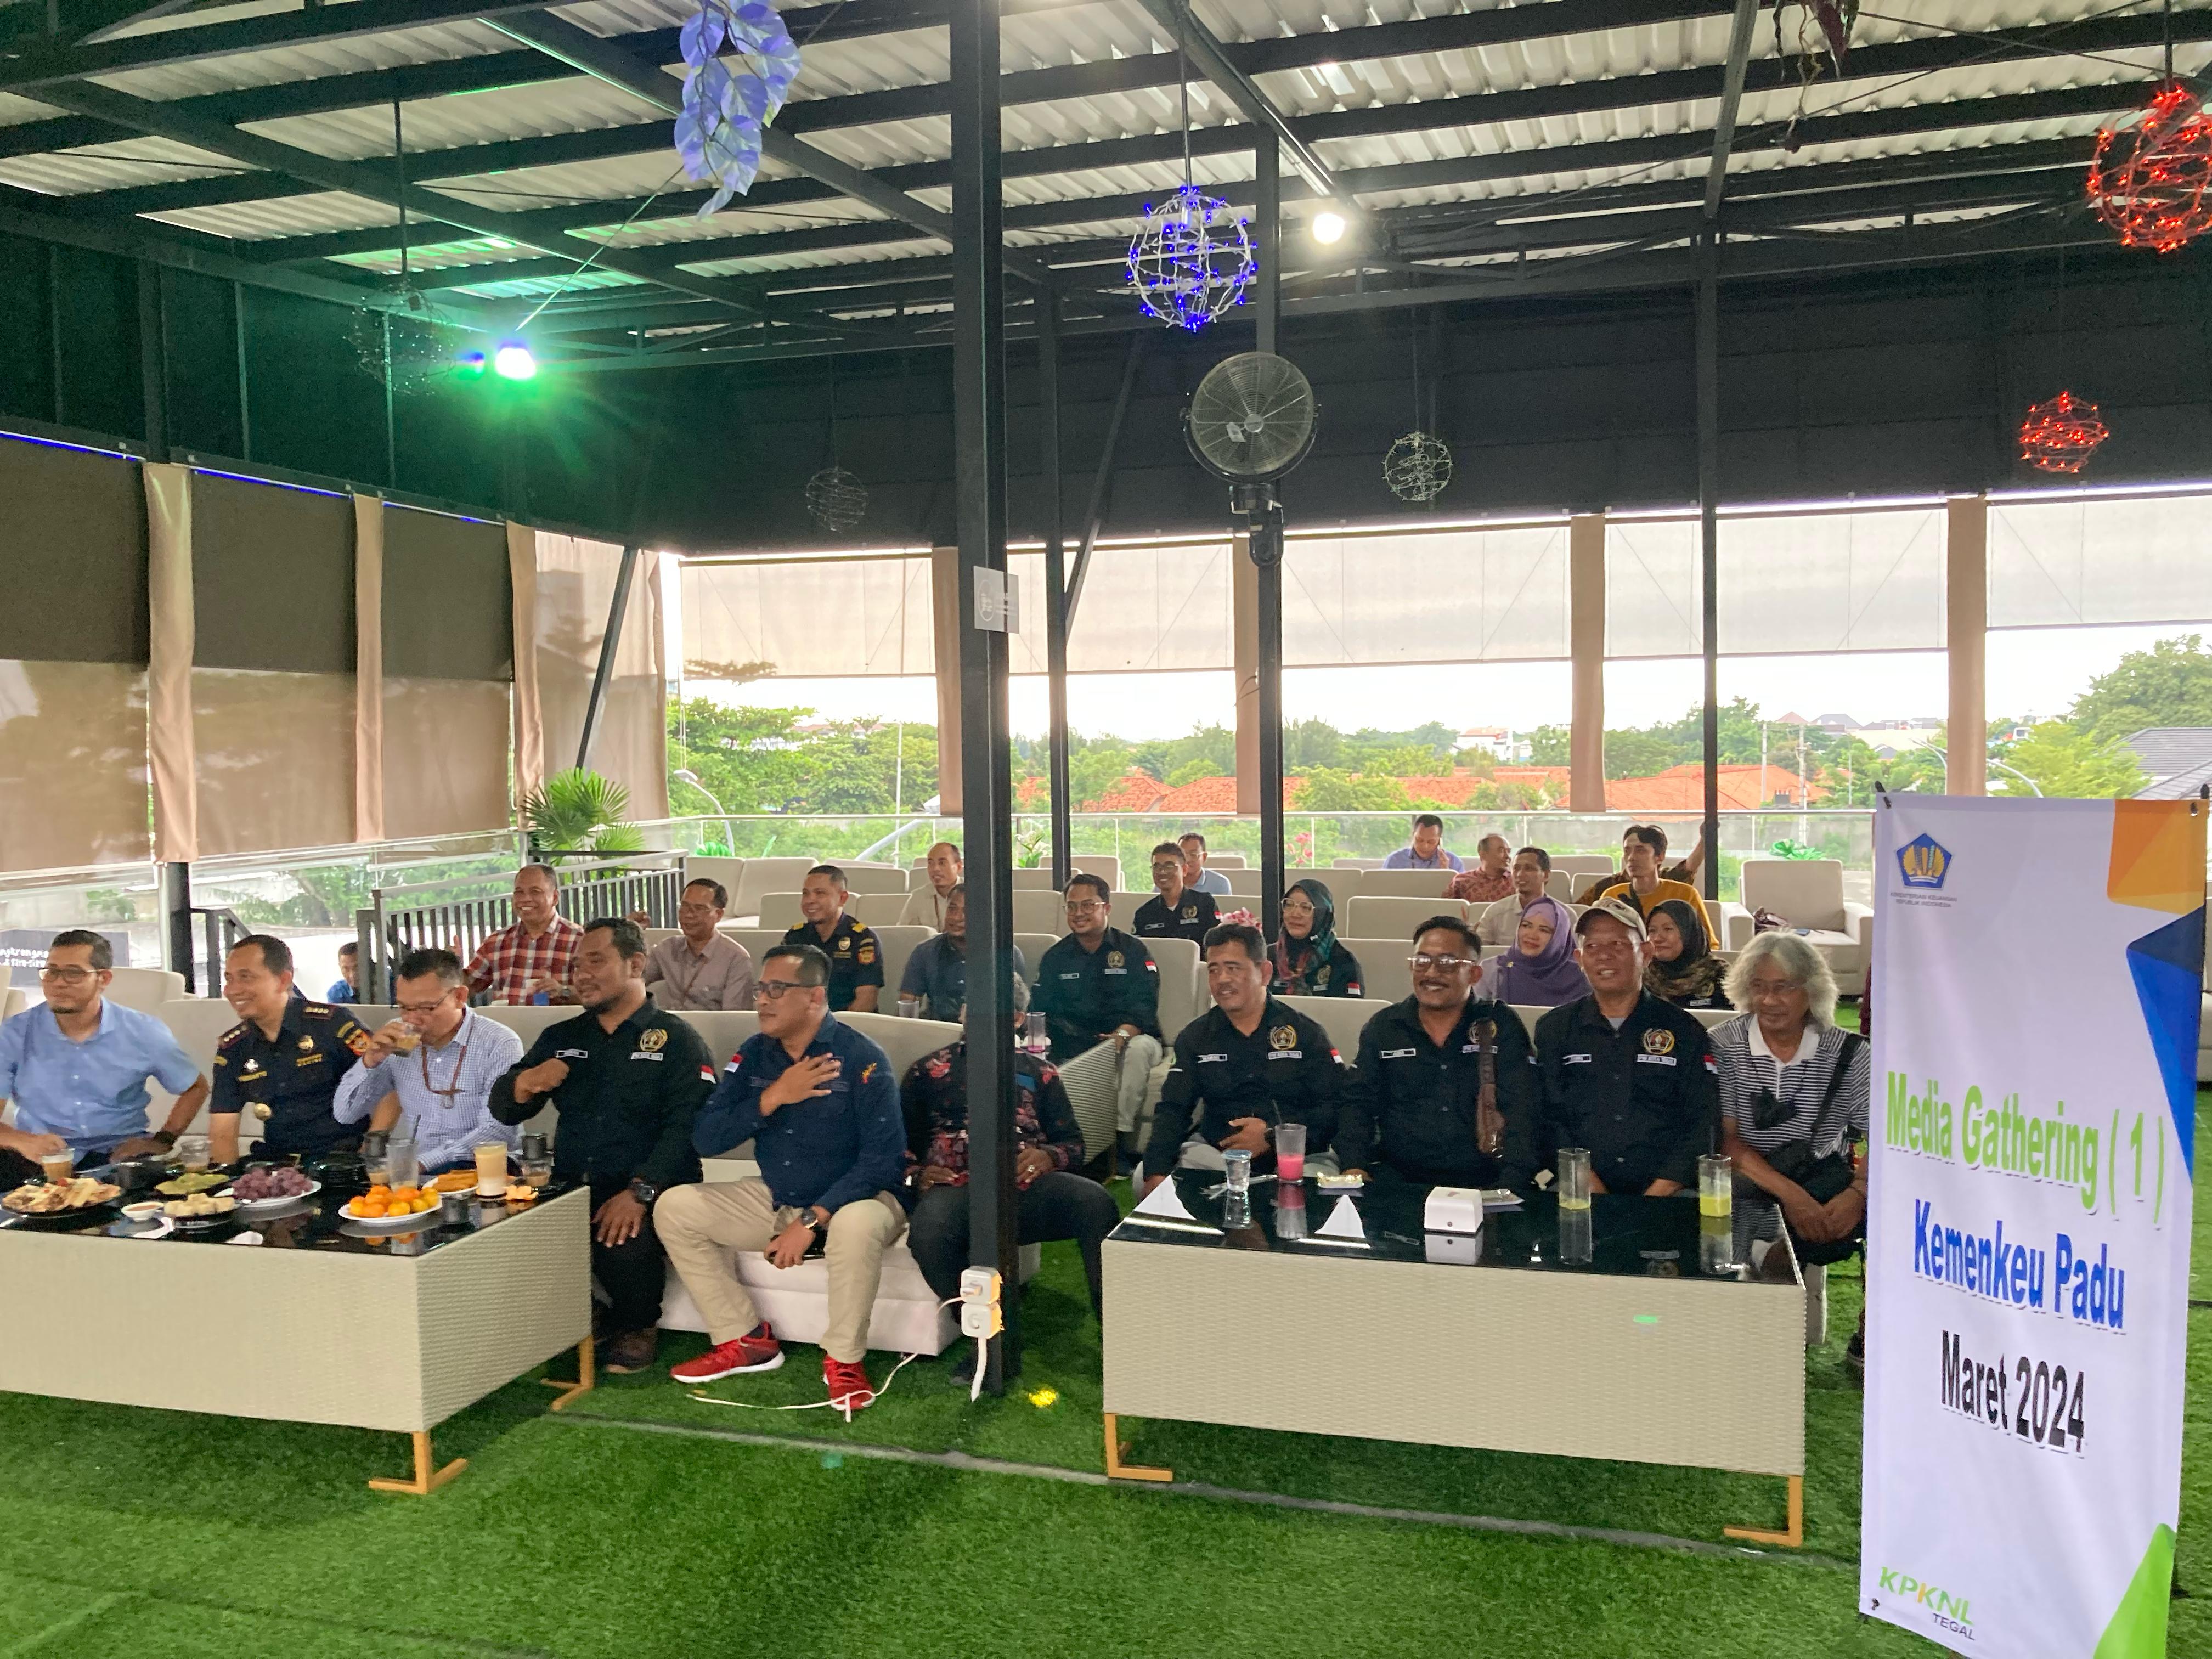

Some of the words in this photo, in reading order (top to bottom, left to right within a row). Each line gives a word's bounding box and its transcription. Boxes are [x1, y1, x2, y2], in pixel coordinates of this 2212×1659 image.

[1887, 1071, 1952, 1159] Media
[1962, 1085, 2099, 1210] Gathering
[1915, 1199, 2045, 1308] Kemenkeu
[2054, 1233, 2125, 1329] Padu
[1942, 1330, 2008, 1429] Maret
[2016, 1357, 2084, 1453] 2024
[1879, 1566, 1973, 1626] KPKNL
[1933, 1613, 1976, 1641] TEGAL
